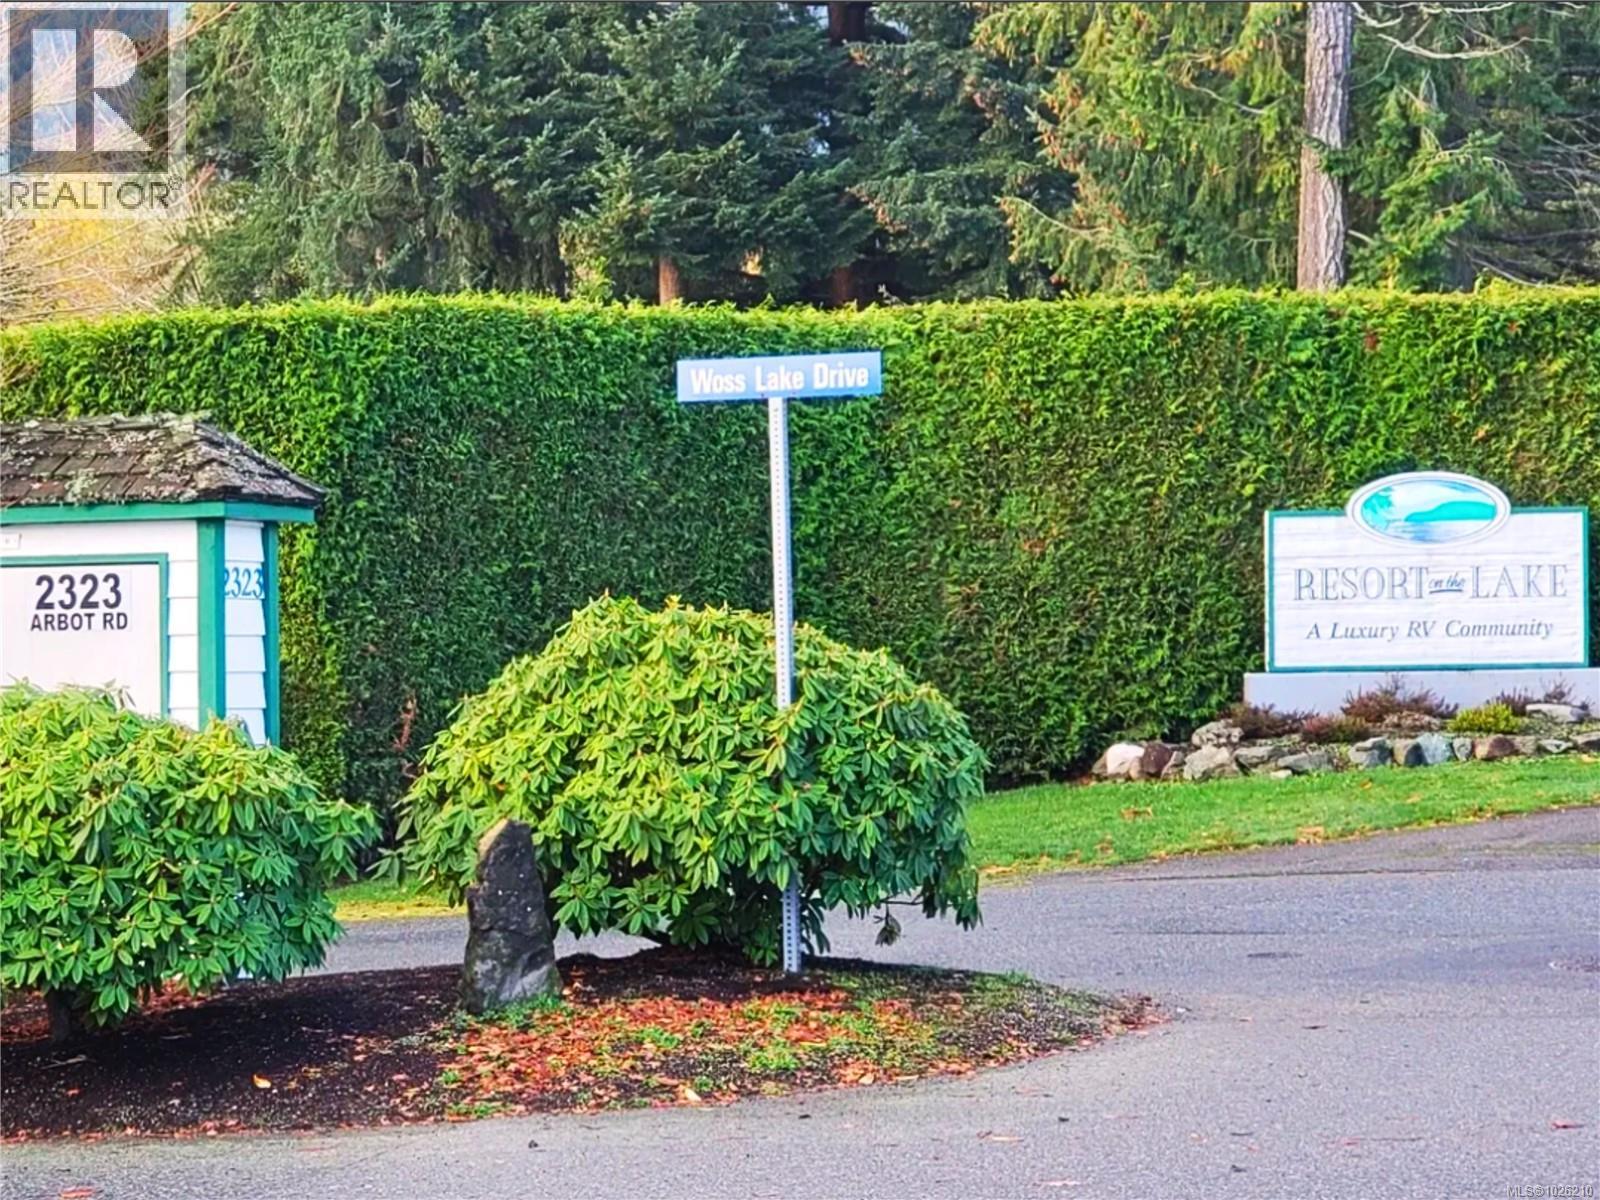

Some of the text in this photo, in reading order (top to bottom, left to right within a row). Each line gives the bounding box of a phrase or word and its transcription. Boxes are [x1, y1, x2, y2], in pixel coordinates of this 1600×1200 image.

[690, 361, 869, 394] Woss Lake Drive
[35, 573, 122, 610] 2323
[1293, 563, 1568, 601] RESORT on the LAKE
[30, 612, 128, 632] ARBOT RD
[1305, 618, 1554, 643] A Luxury RV Community
